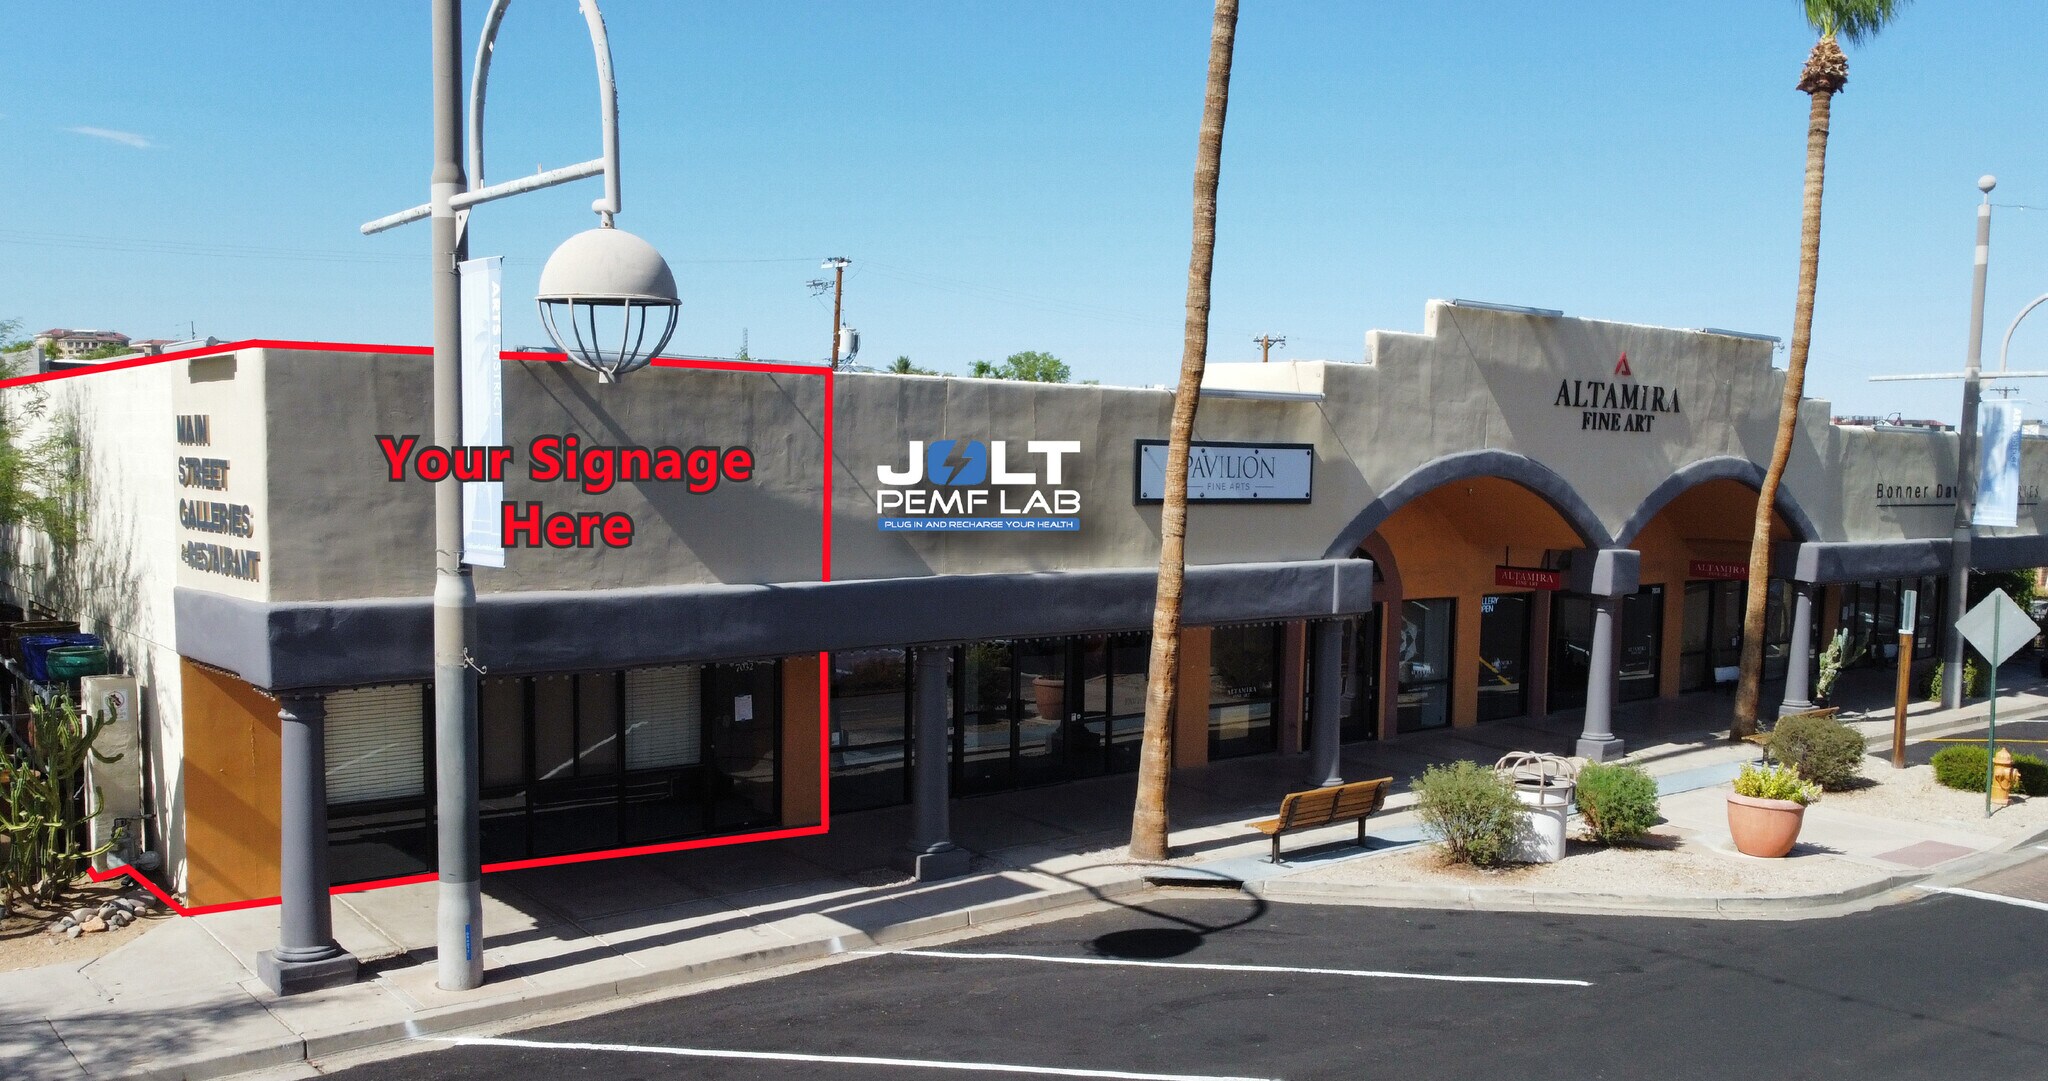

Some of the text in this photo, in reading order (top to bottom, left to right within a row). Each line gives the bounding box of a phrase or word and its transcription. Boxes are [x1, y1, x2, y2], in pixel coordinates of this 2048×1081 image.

[1553, 379, 1680, 413] ALTAMIRA
[176, 414, 211, 446] MAIN
[1581, 411, 1655, 433] FINE ART
[178, 456, 230, 492] STREET
[1207, 482, 1250, 491] FINE ARTS
[1877, 483, 1929, 499] Bonner
[179, 498, 254, 538] GALLERIES
[187, 540, 260, 582] RESTAURANT
[1696, 563, 1746, 574] ALTAMIRA
[1501, 571, 1554, 583] ALTAMIRA
[1481, 596, 1499, 605] LLERY
